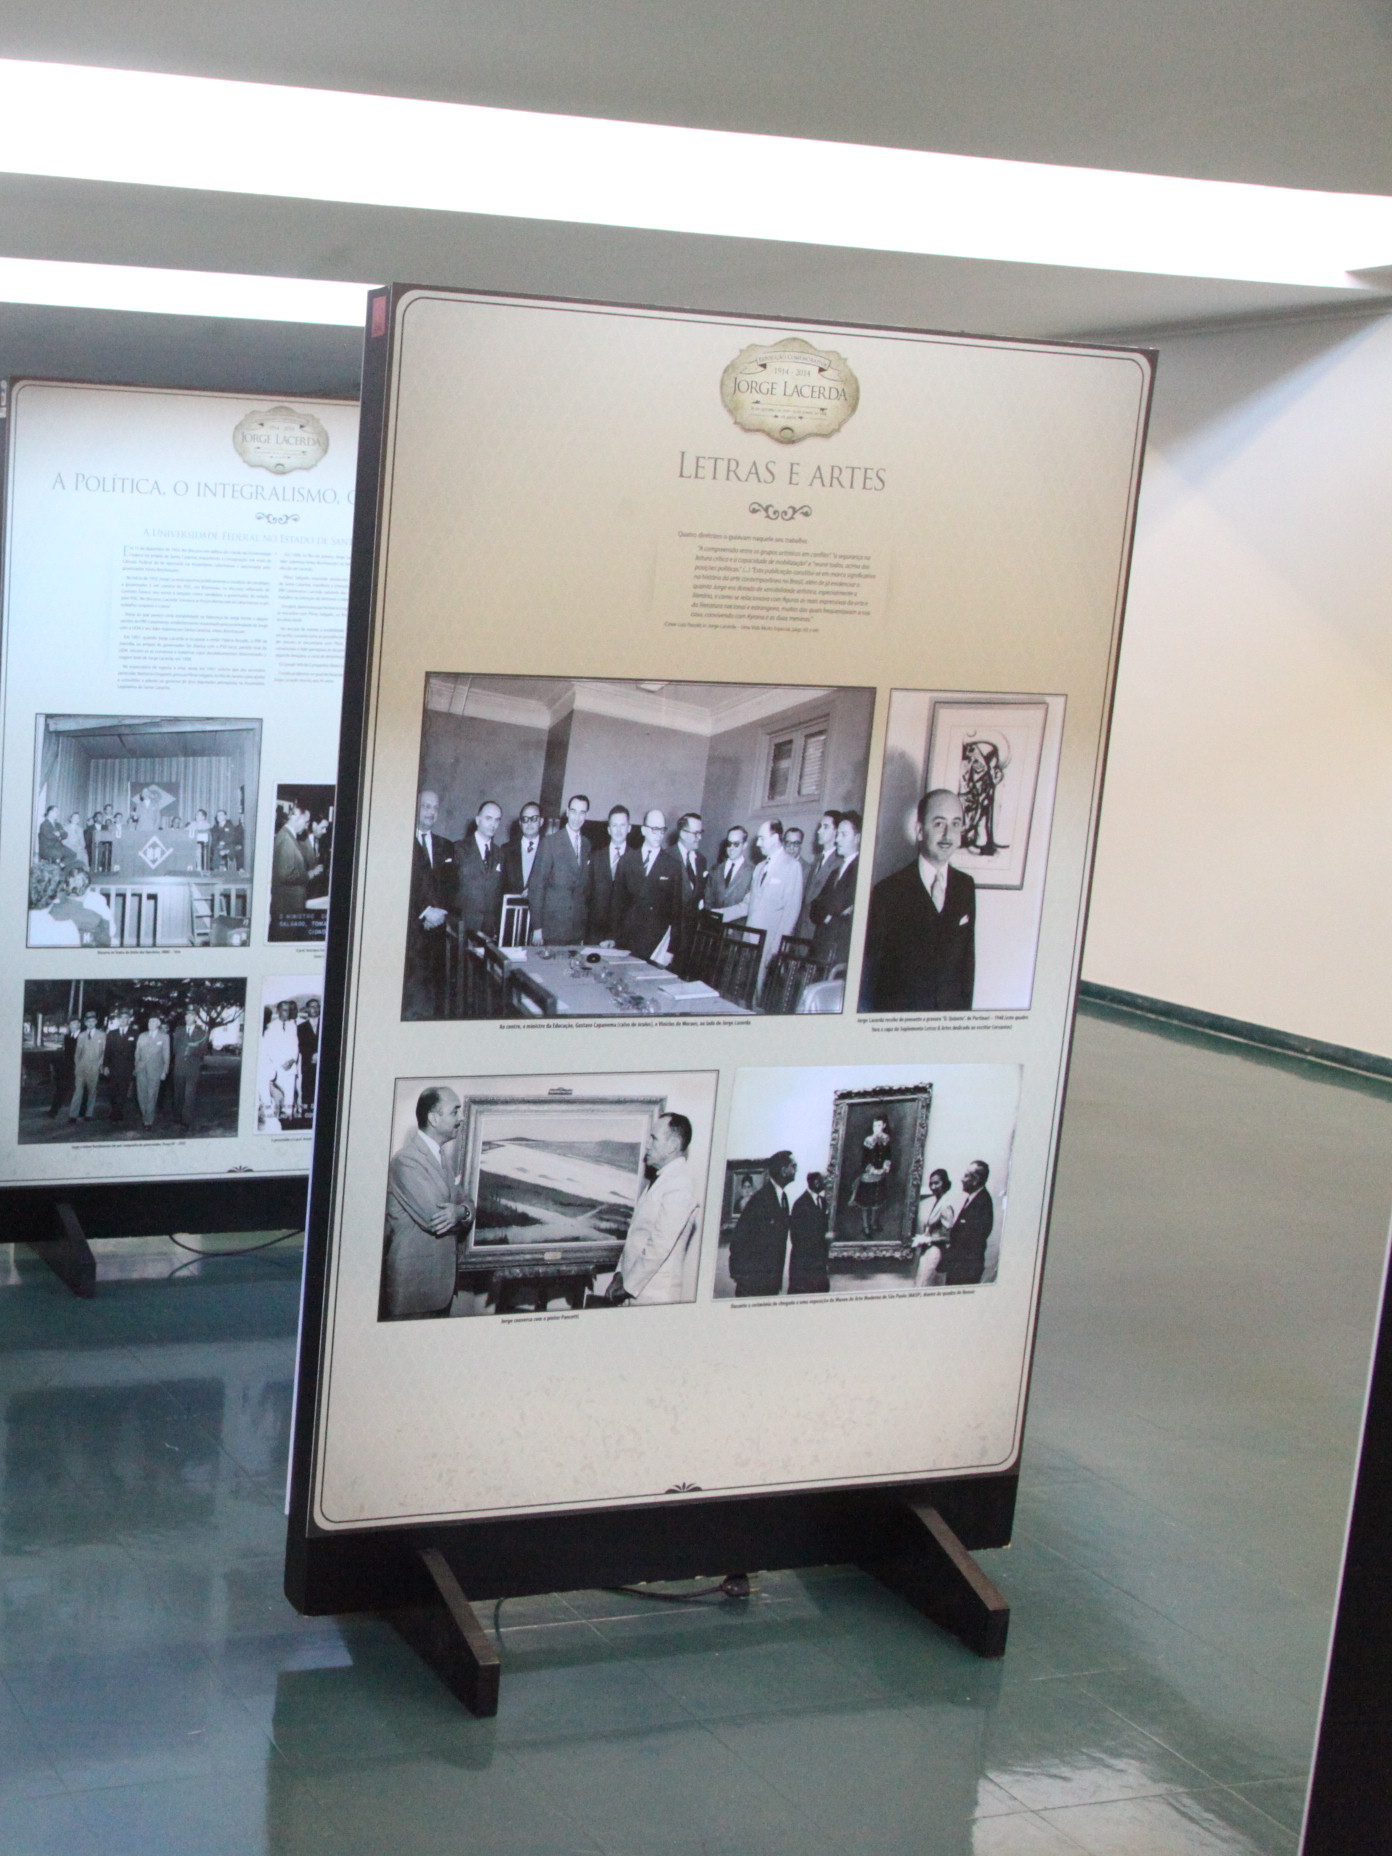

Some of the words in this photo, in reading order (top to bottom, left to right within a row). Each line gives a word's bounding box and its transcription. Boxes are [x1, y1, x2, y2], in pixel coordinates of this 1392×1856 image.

[732, 376, 778, 396] JORGE
[783, 380, 849, 402] LACERDA
[241, 431, 273, 444] JORGE
[276, 433, 323, 448] LACERDA
[678, 450, 776, 485] LETRAS
[788, 462, 801, 486] E
[808, 464, 887, 492] ARTES
[52, 472, 66, 491] A
[173, 480, 189, 496] O
[151, 528, 218, 541] UNIVERSIDADE
[222, 532, 259, 542] FEDERAL
[279, 534, 315, 545] ESTADO
